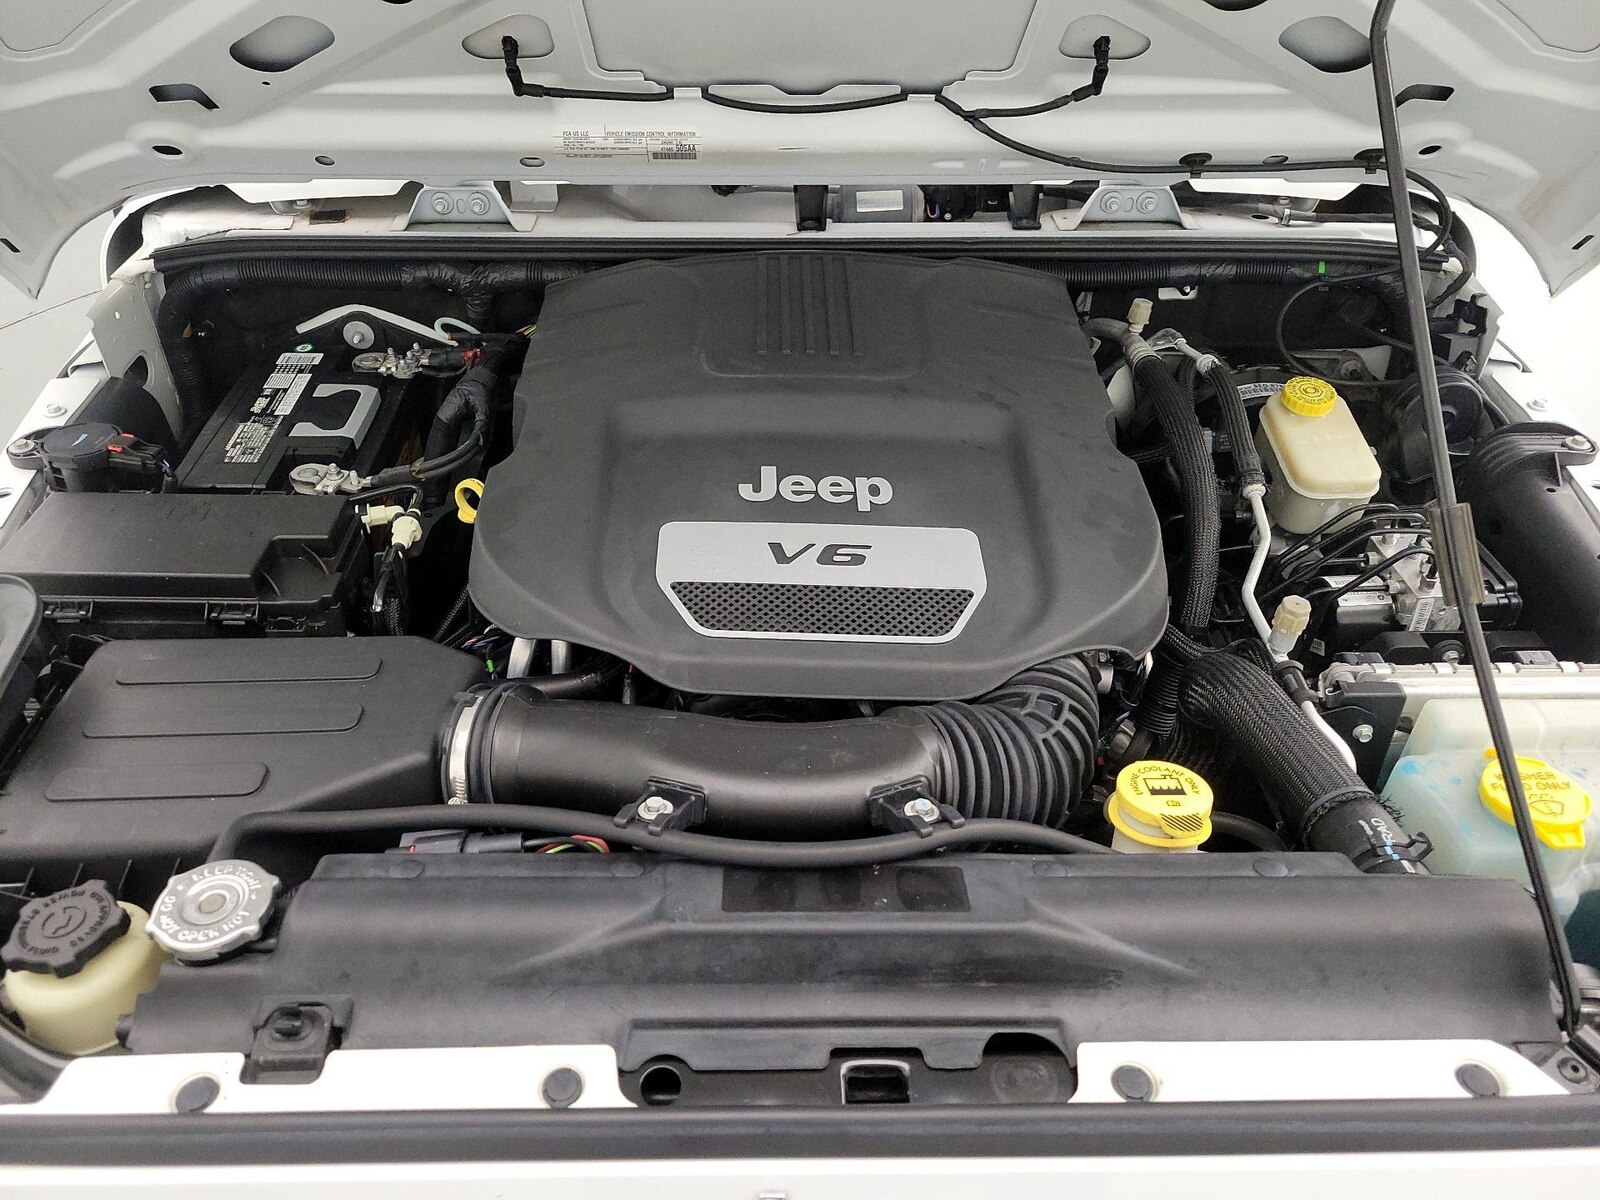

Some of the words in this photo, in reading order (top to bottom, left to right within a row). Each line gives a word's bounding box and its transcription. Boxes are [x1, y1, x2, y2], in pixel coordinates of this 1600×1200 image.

[738, 465, 893, 512] Jeep
[767, 542, 873, 567] V6
[1130, 773, 1144, 796] ENGINE
[1138, 765, 1186, 777] COOLANT
[1185, 777, 1201, 795] ONLY
[1494, 772, 1556, 781] WSHER
[1536, 782, 1571, 791] ONLY
